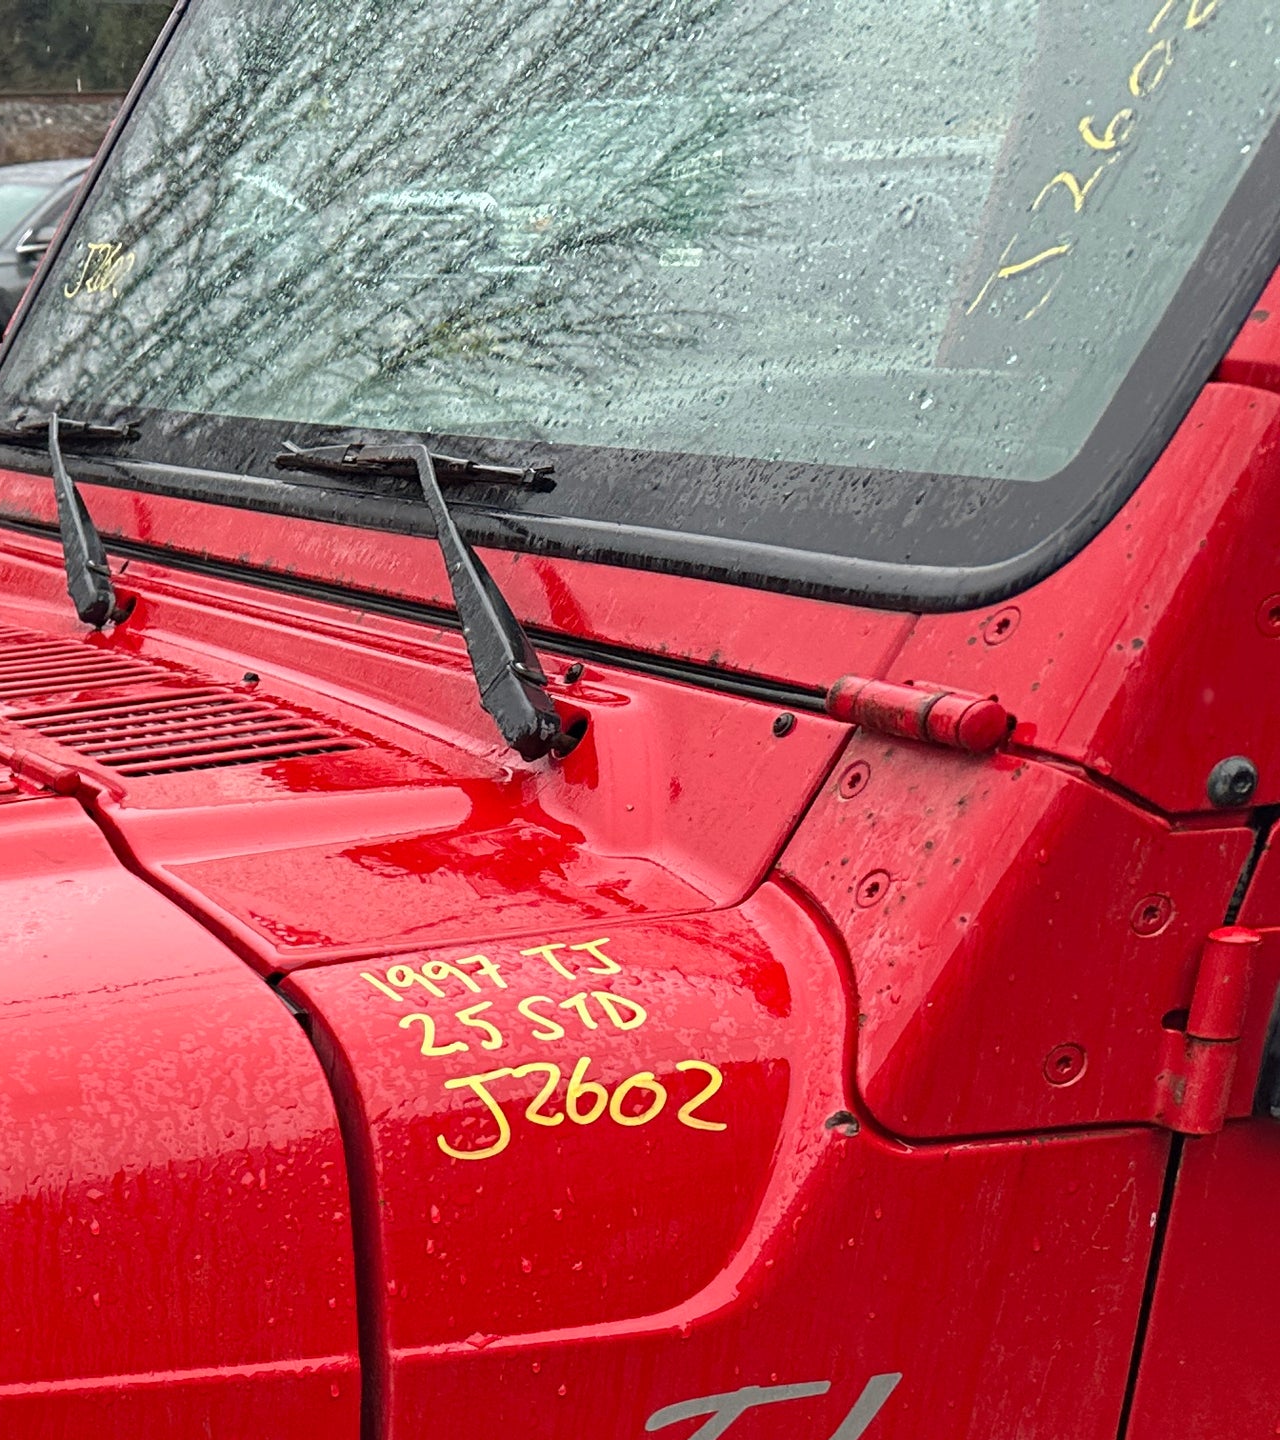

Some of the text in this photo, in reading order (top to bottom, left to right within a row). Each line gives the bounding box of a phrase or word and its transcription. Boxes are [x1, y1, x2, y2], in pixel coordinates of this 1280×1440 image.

[360, 937, 622, 1002] 1997 TJ
[518, 991, 647, 1042] STD
[437, 1056, 728, 1160] J2602
